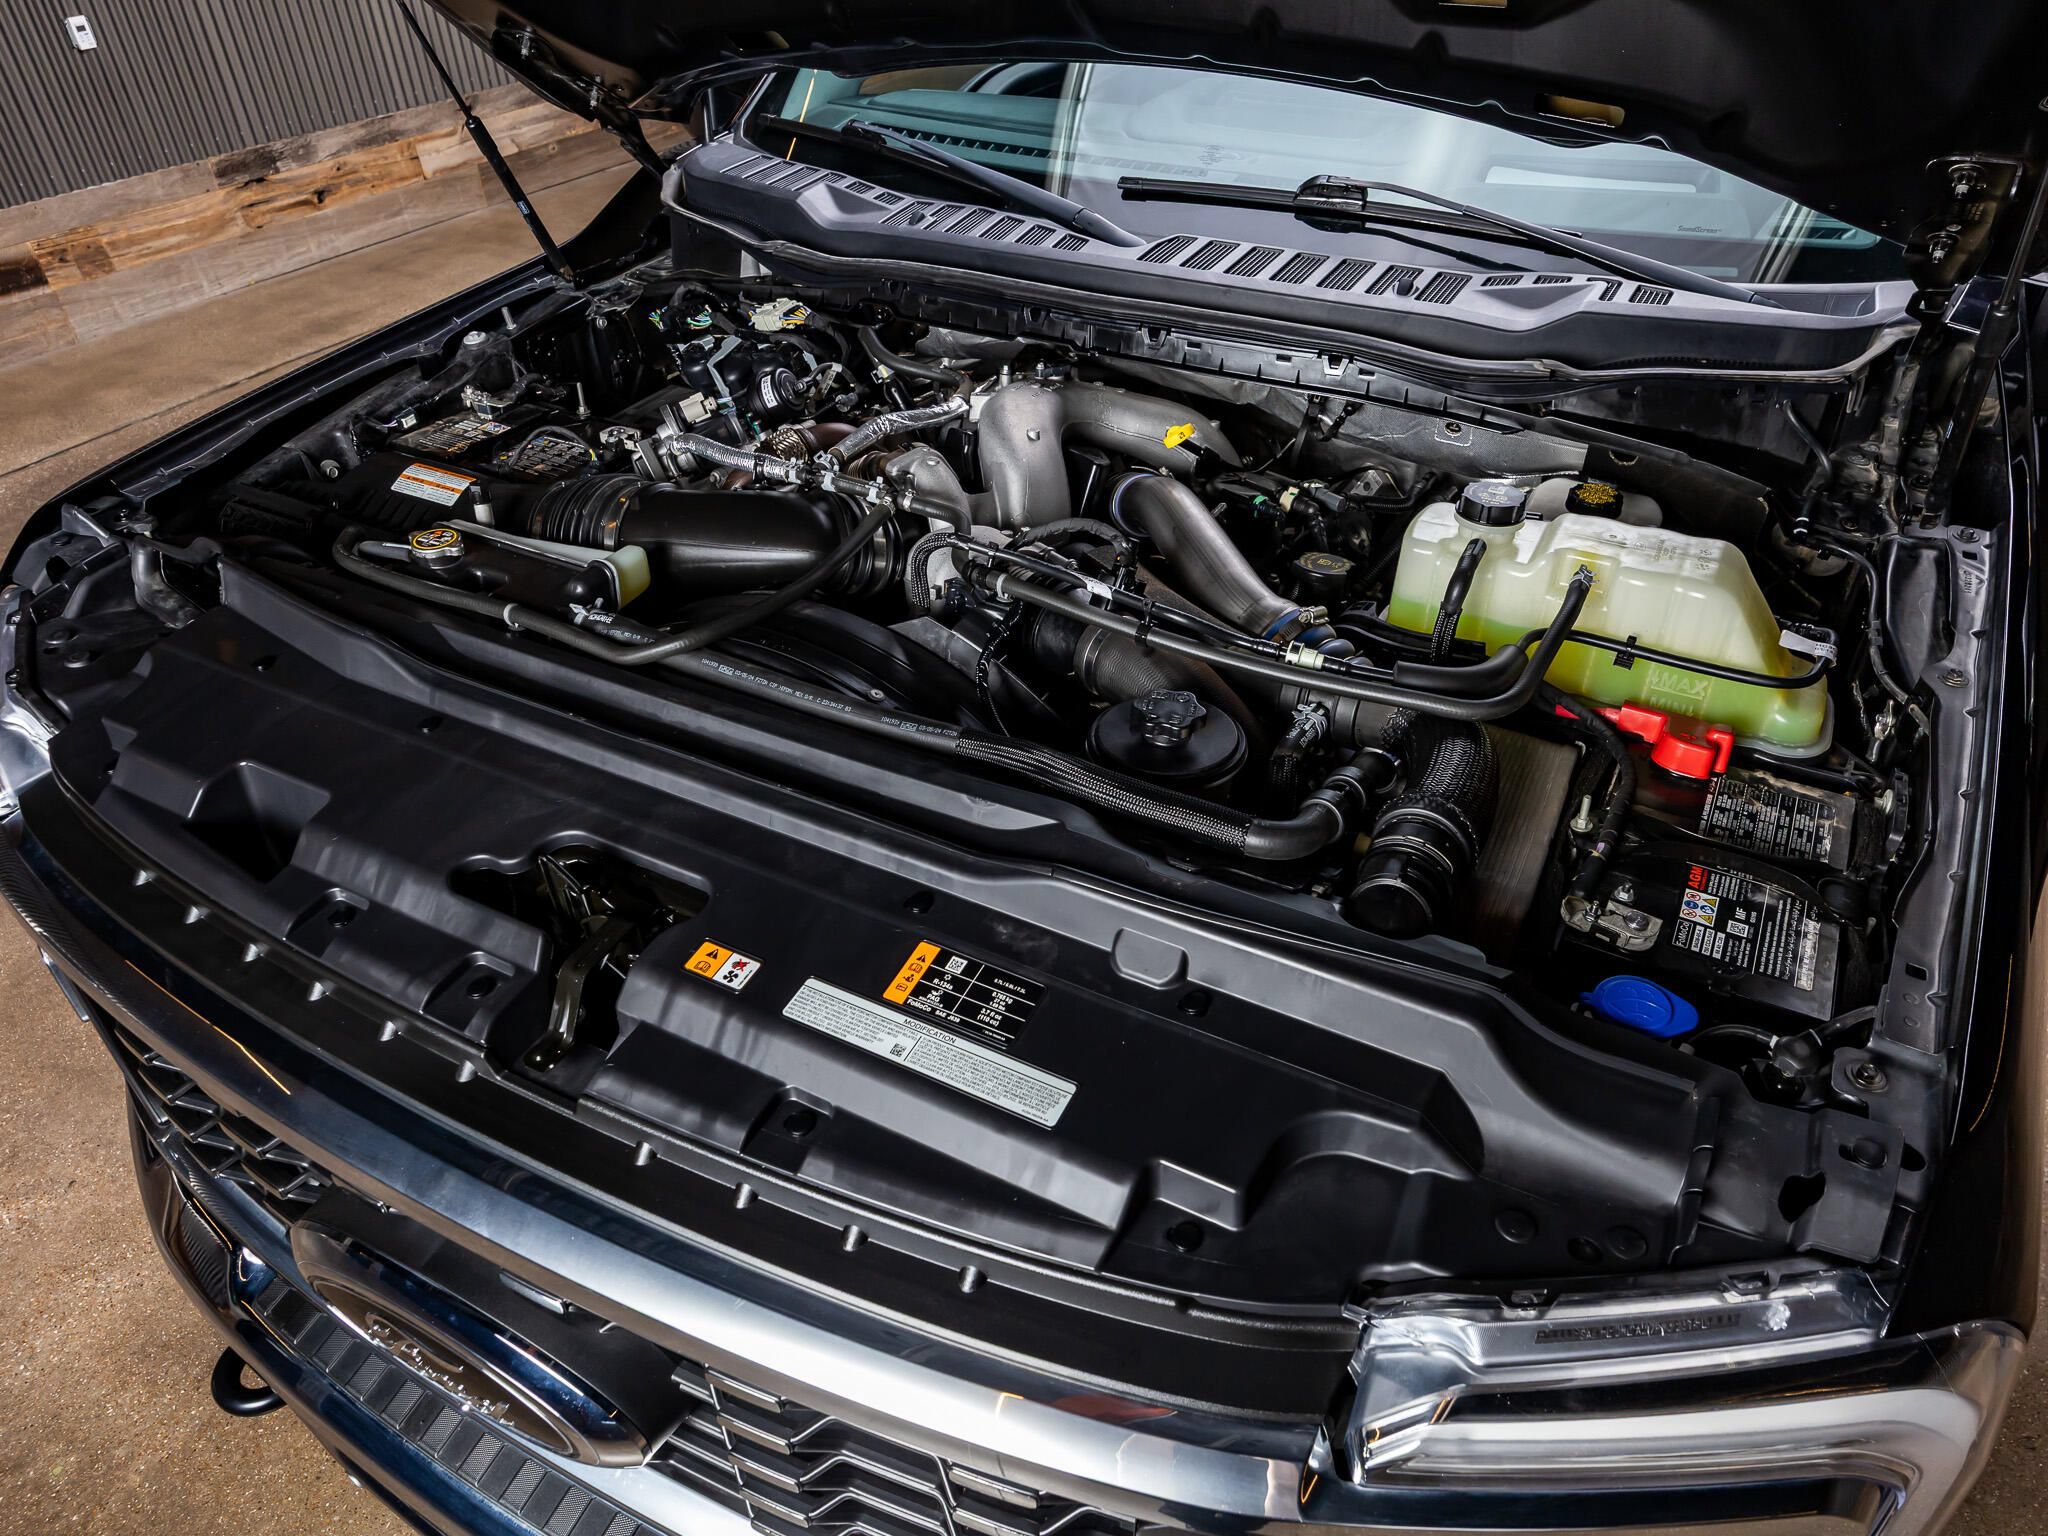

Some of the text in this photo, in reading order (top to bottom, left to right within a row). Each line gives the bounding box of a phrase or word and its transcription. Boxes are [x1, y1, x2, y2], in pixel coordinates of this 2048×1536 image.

[1662, 674, 1708, 697] MAX
[1687, 866, 1703, 889] AGM
[1676, 922, 1690, 946] FoMoCo
[931, 978, 954, 990] R-134a
[906, 998, 932, 1012] FoMoCo
[934, 1009, 947, 1017] SAE
[925, 993, 941, 1002] PAG
[903, 1018, 956, 1044] MODIFICATION
